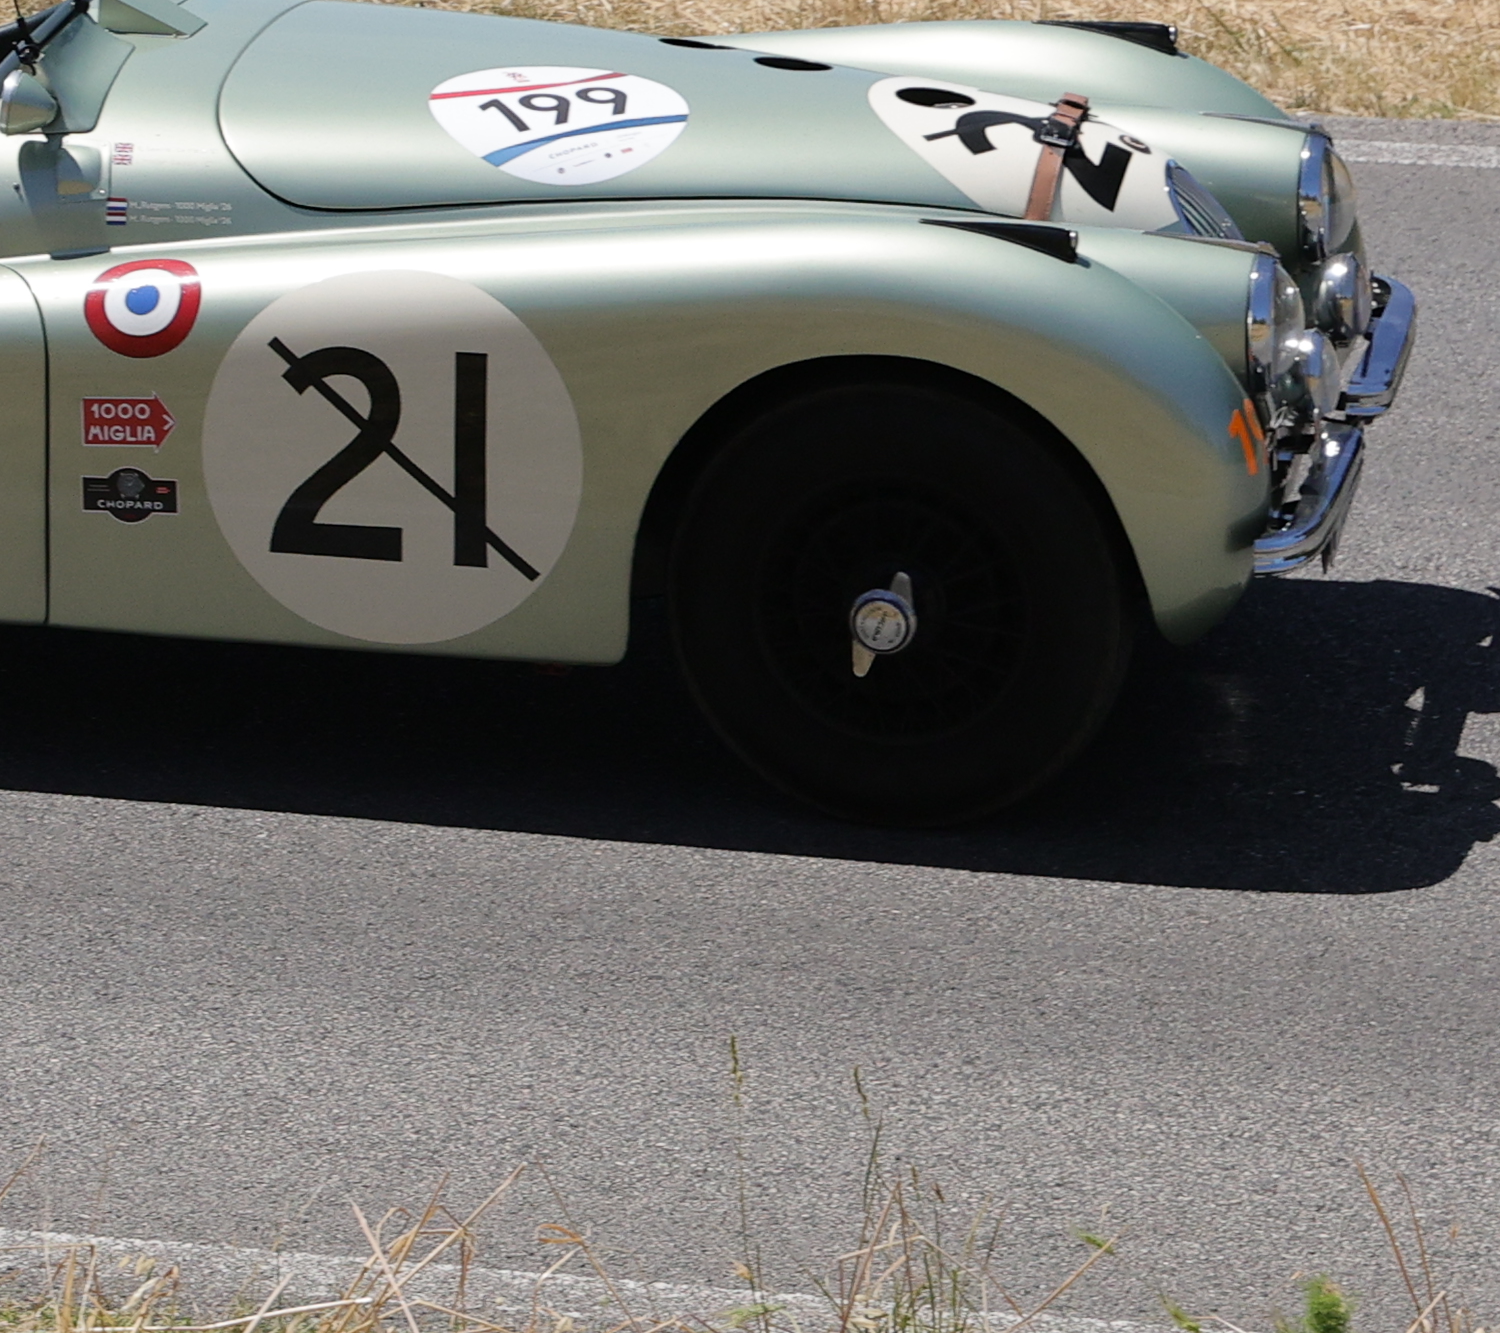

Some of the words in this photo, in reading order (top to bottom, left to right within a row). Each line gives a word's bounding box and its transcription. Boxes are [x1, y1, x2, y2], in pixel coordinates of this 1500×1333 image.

[478, 87, 627, 132] 199
[90, 403, 151, 419] 1000
[88, 425, 156, 442] MIGLIA
[268, 346, 488, 568] 21
[96, 499, 164, 510] CHOPARD
